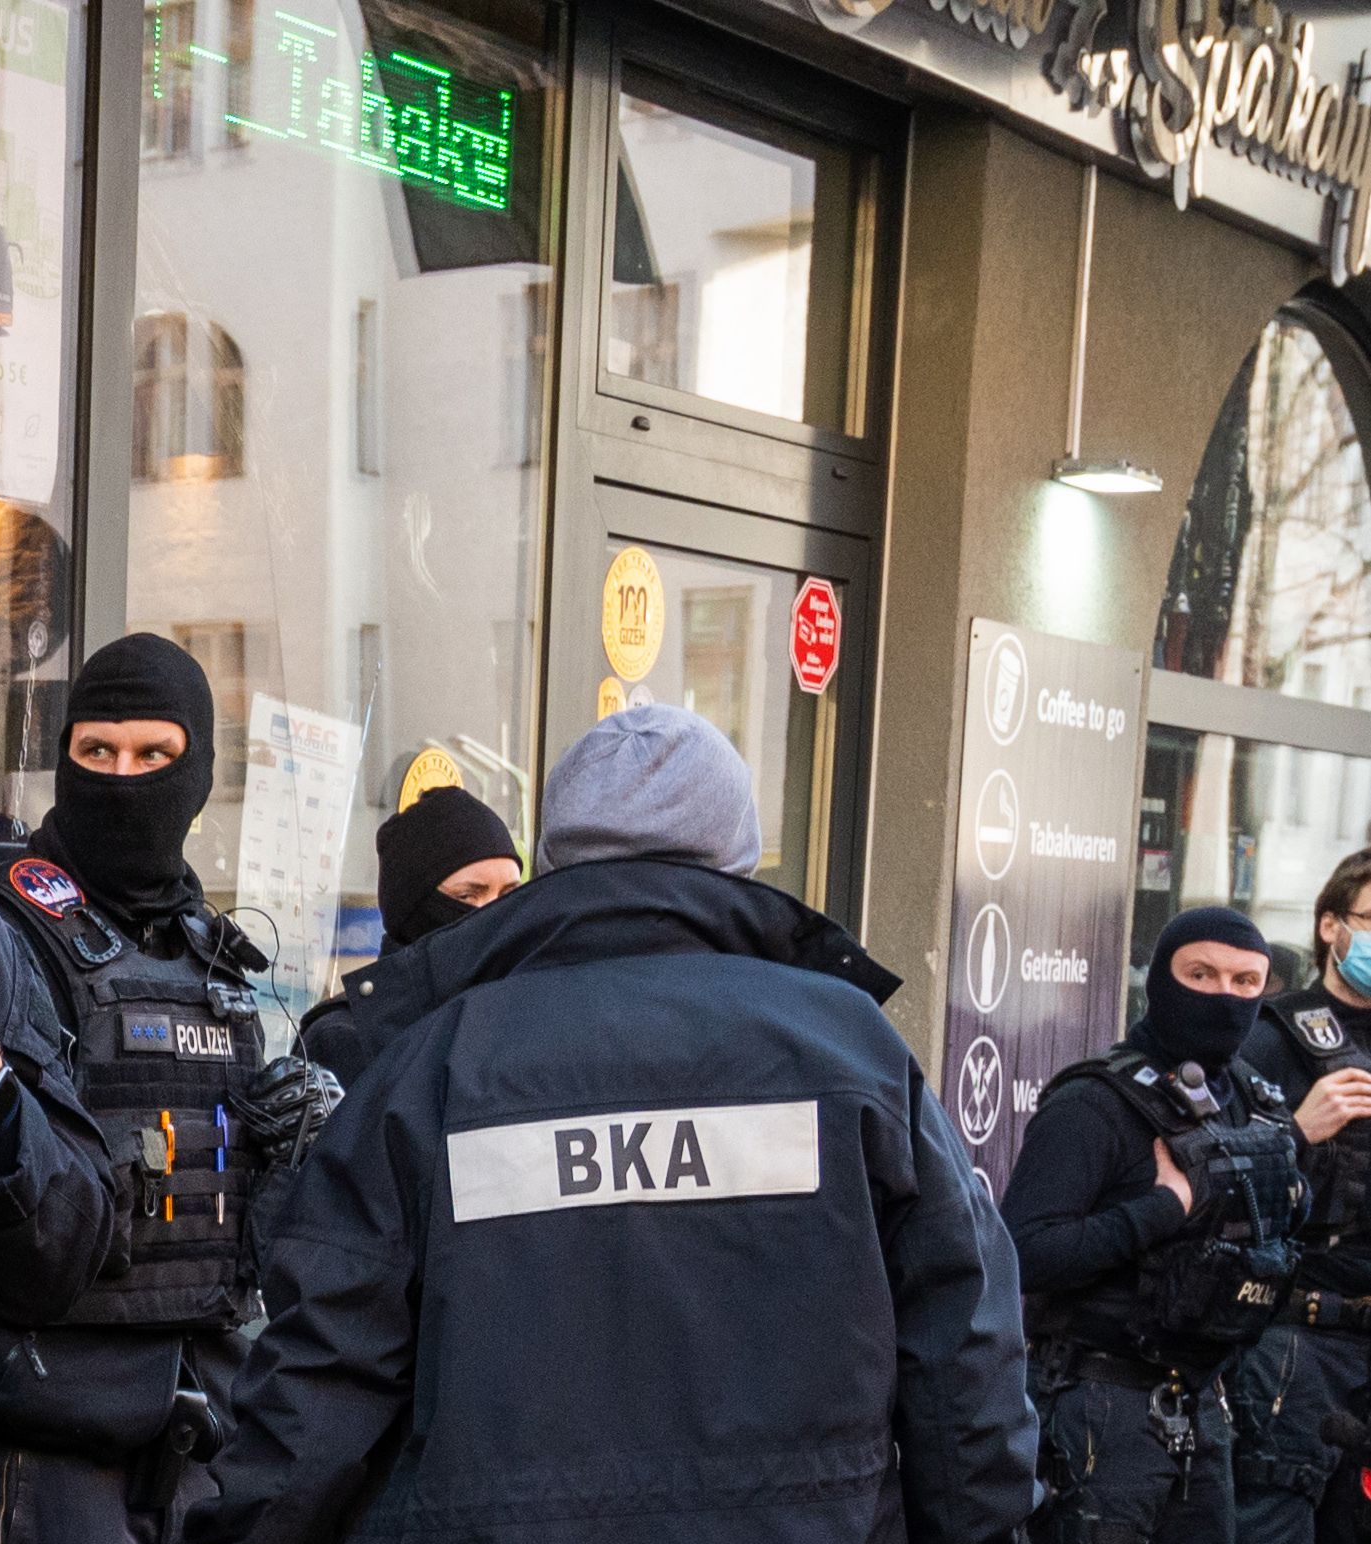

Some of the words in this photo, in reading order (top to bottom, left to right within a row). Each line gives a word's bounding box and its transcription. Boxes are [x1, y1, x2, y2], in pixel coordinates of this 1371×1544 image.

[9, 362, 16, 383] 5
[19, 364, 27, 386] €
[619, 627, 645, 646] GIZEH
[1037, 688, 1085, 728] Coffee
[1088, 701, 1104, 730] to
[1106, 706, 1125, 741] go
[1029, 821, 1116, 864] Tabakwaren
[1021, 947, 1088, 985] Getränke
[176, 1022, 233, 1057] POLIZEI
[554, 1119, 712, 1197] BKA
